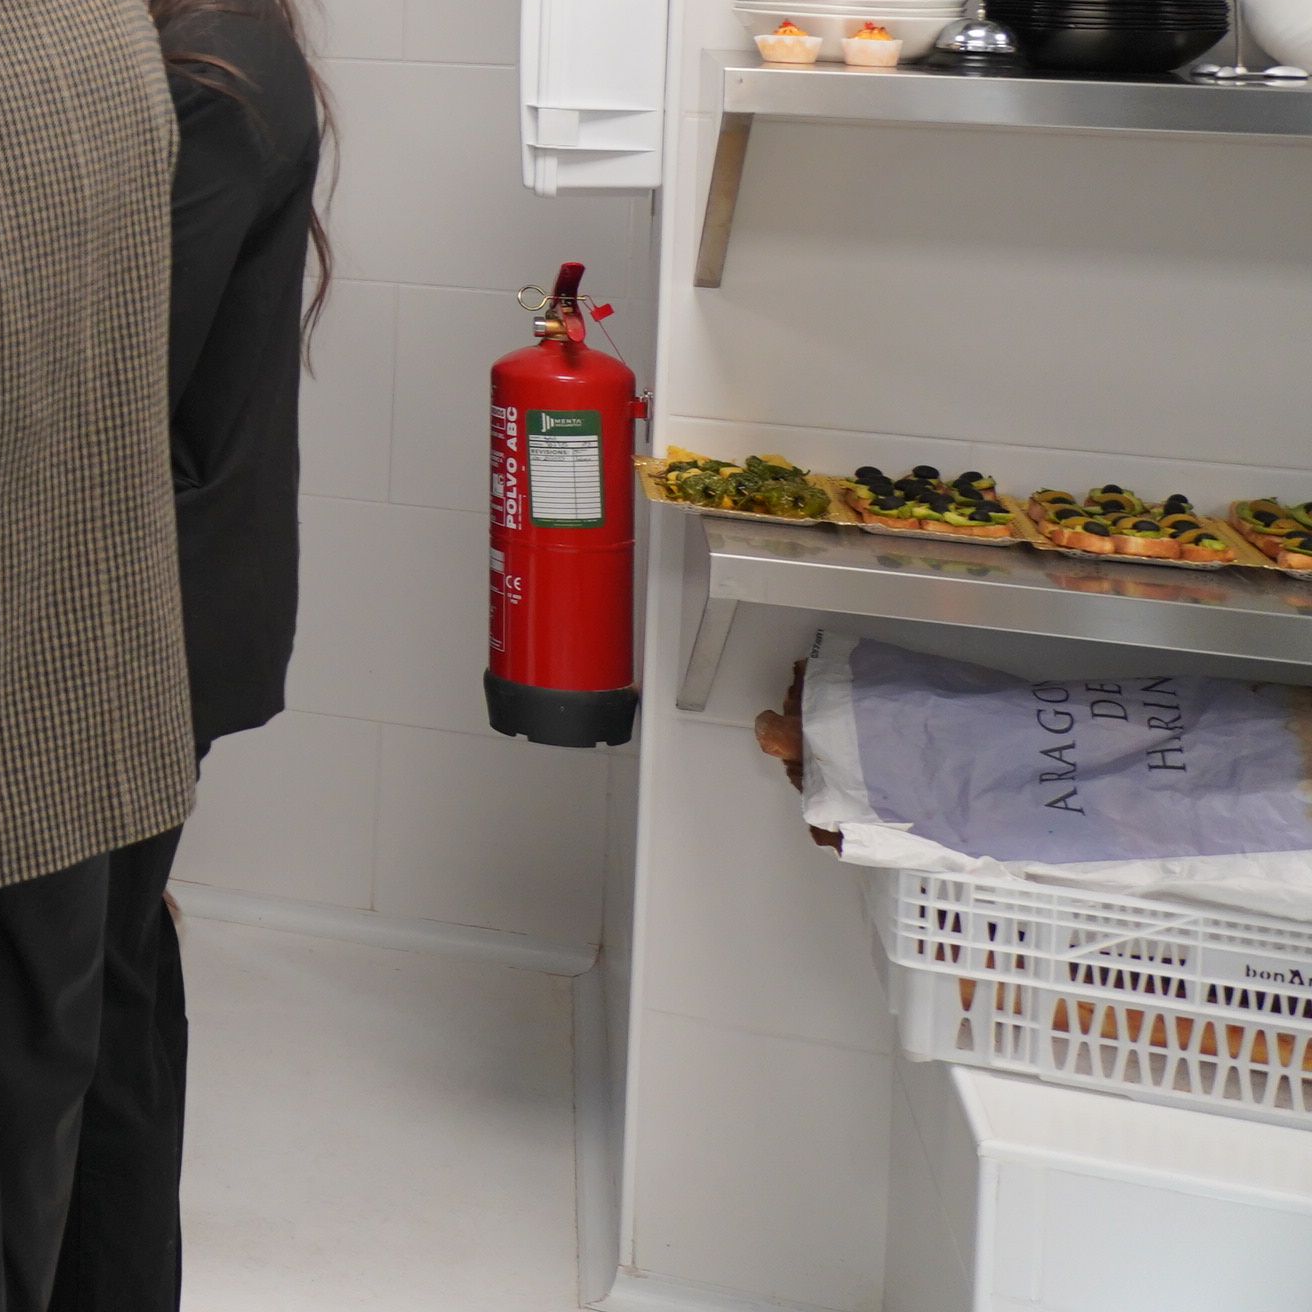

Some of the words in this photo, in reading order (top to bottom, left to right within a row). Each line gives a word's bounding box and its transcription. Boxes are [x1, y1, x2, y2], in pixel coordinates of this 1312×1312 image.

[506, 406, 518, 452] ABC
[506, 457, 518, 530] POLVO
[1085, 682, 1128, 722] DE
[1141, 677, 1187, 772] HRIN
